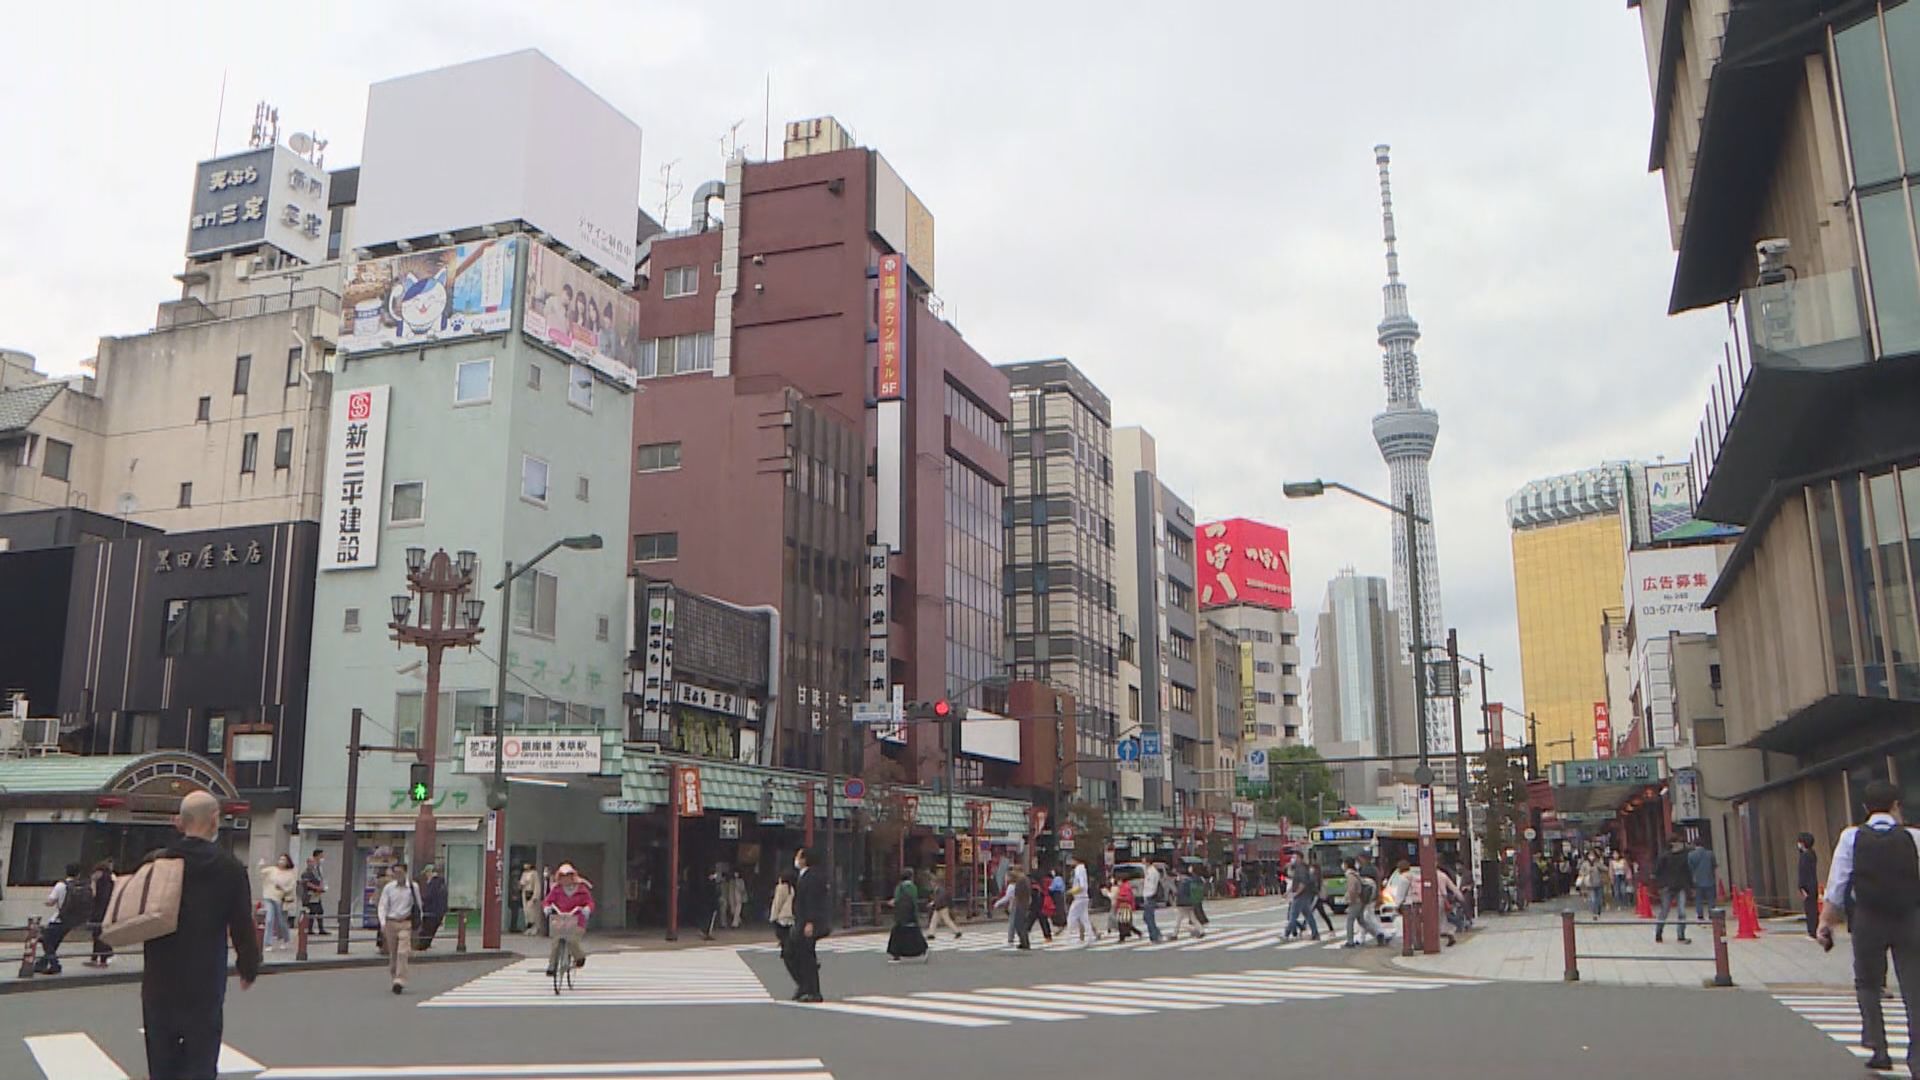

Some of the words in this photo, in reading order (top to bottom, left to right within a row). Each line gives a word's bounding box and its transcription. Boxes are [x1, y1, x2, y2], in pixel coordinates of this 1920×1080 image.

[208, 165, 257, 192] 天ぷら
[337, 423, 368, 563] 新三平建設
[154, 540, 262, 573] 黒田屋本店
[1643, 573, 1708, 591] 広告募集
